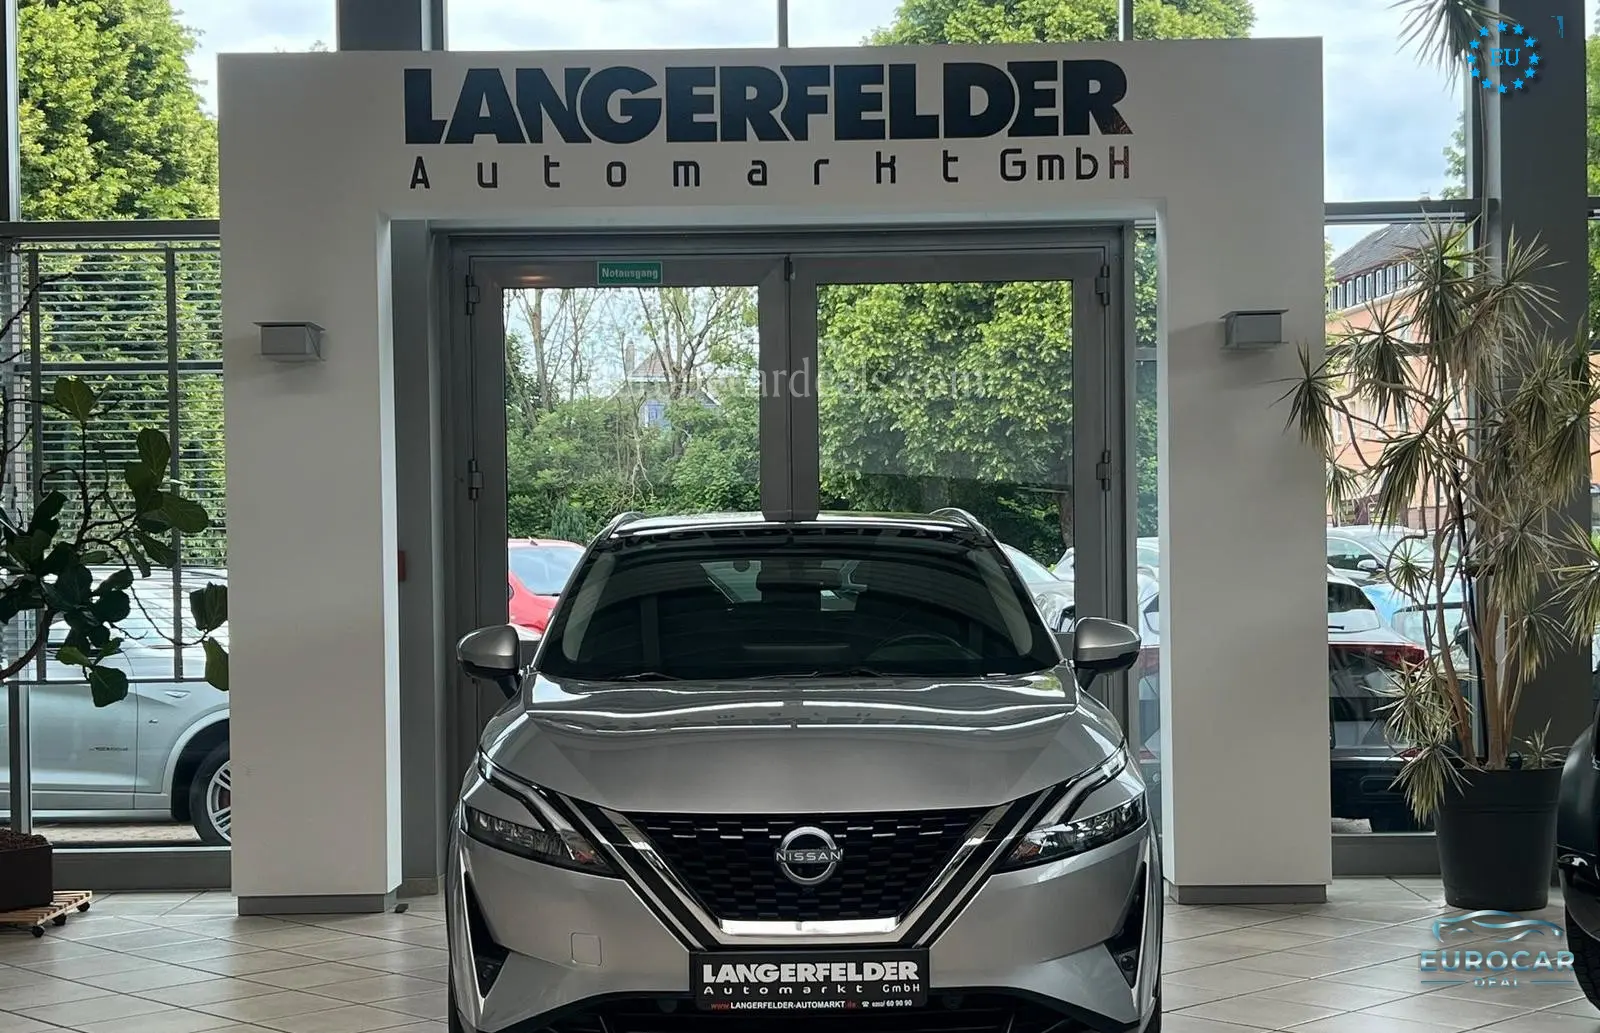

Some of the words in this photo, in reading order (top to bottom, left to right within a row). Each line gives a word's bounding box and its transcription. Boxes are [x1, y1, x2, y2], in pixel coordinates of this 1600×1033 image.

[404, 60, 1133, 144] LANGERFELDER
[410, 149, 959, 189] Automarkt
[1000, 146, 1130, 182] GmbH
[602, 267, 658, 280] Notausgang
[776, 851, 841, 861] NISSAN
[703, 961, 920, 983] LANGERFELDER
[703, 984, 863, 995] Automarkt
[882, 983, 920, 993] GmbH
